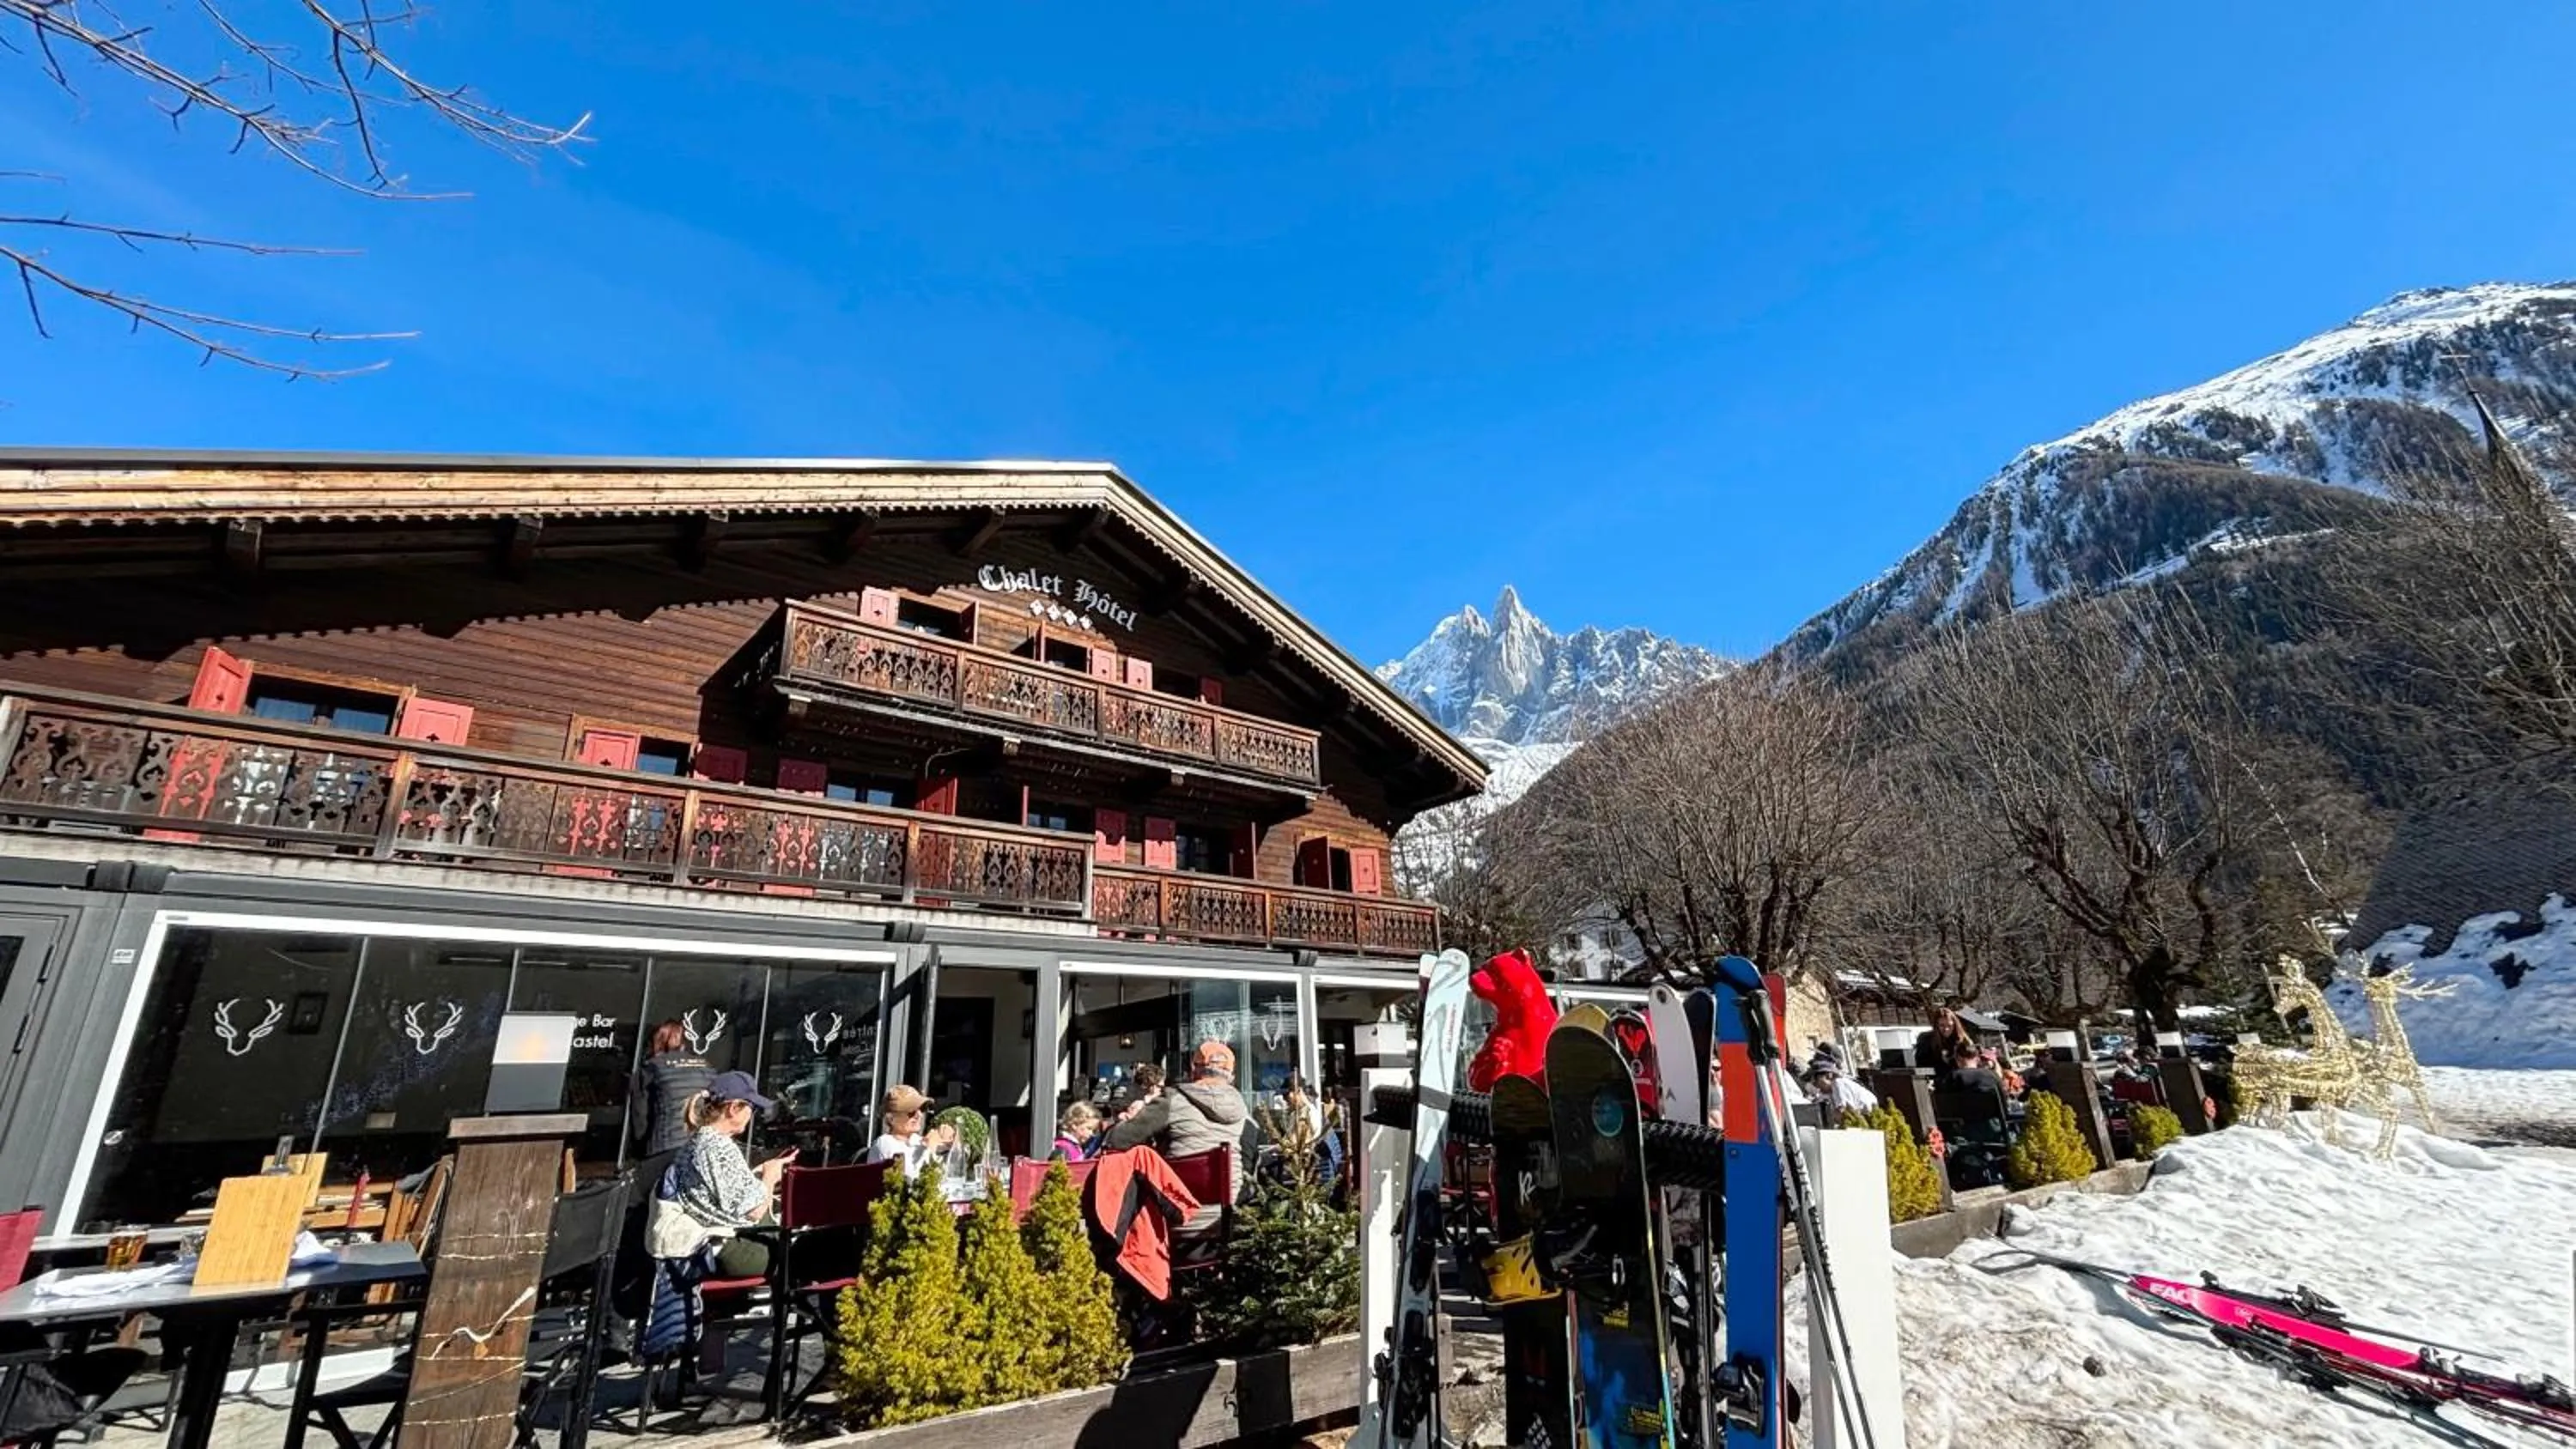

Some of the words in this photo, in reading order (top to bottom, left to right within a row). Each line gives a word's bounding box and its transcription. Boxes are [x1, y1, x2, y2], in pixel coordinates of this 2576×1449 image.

[978, 564, 1063, 595] Chalet
[1073, 579, 1138, 632] Hôtel
[592, 1013, 617, 1028] Bar
[571, 1031, 615, 1048] astel
